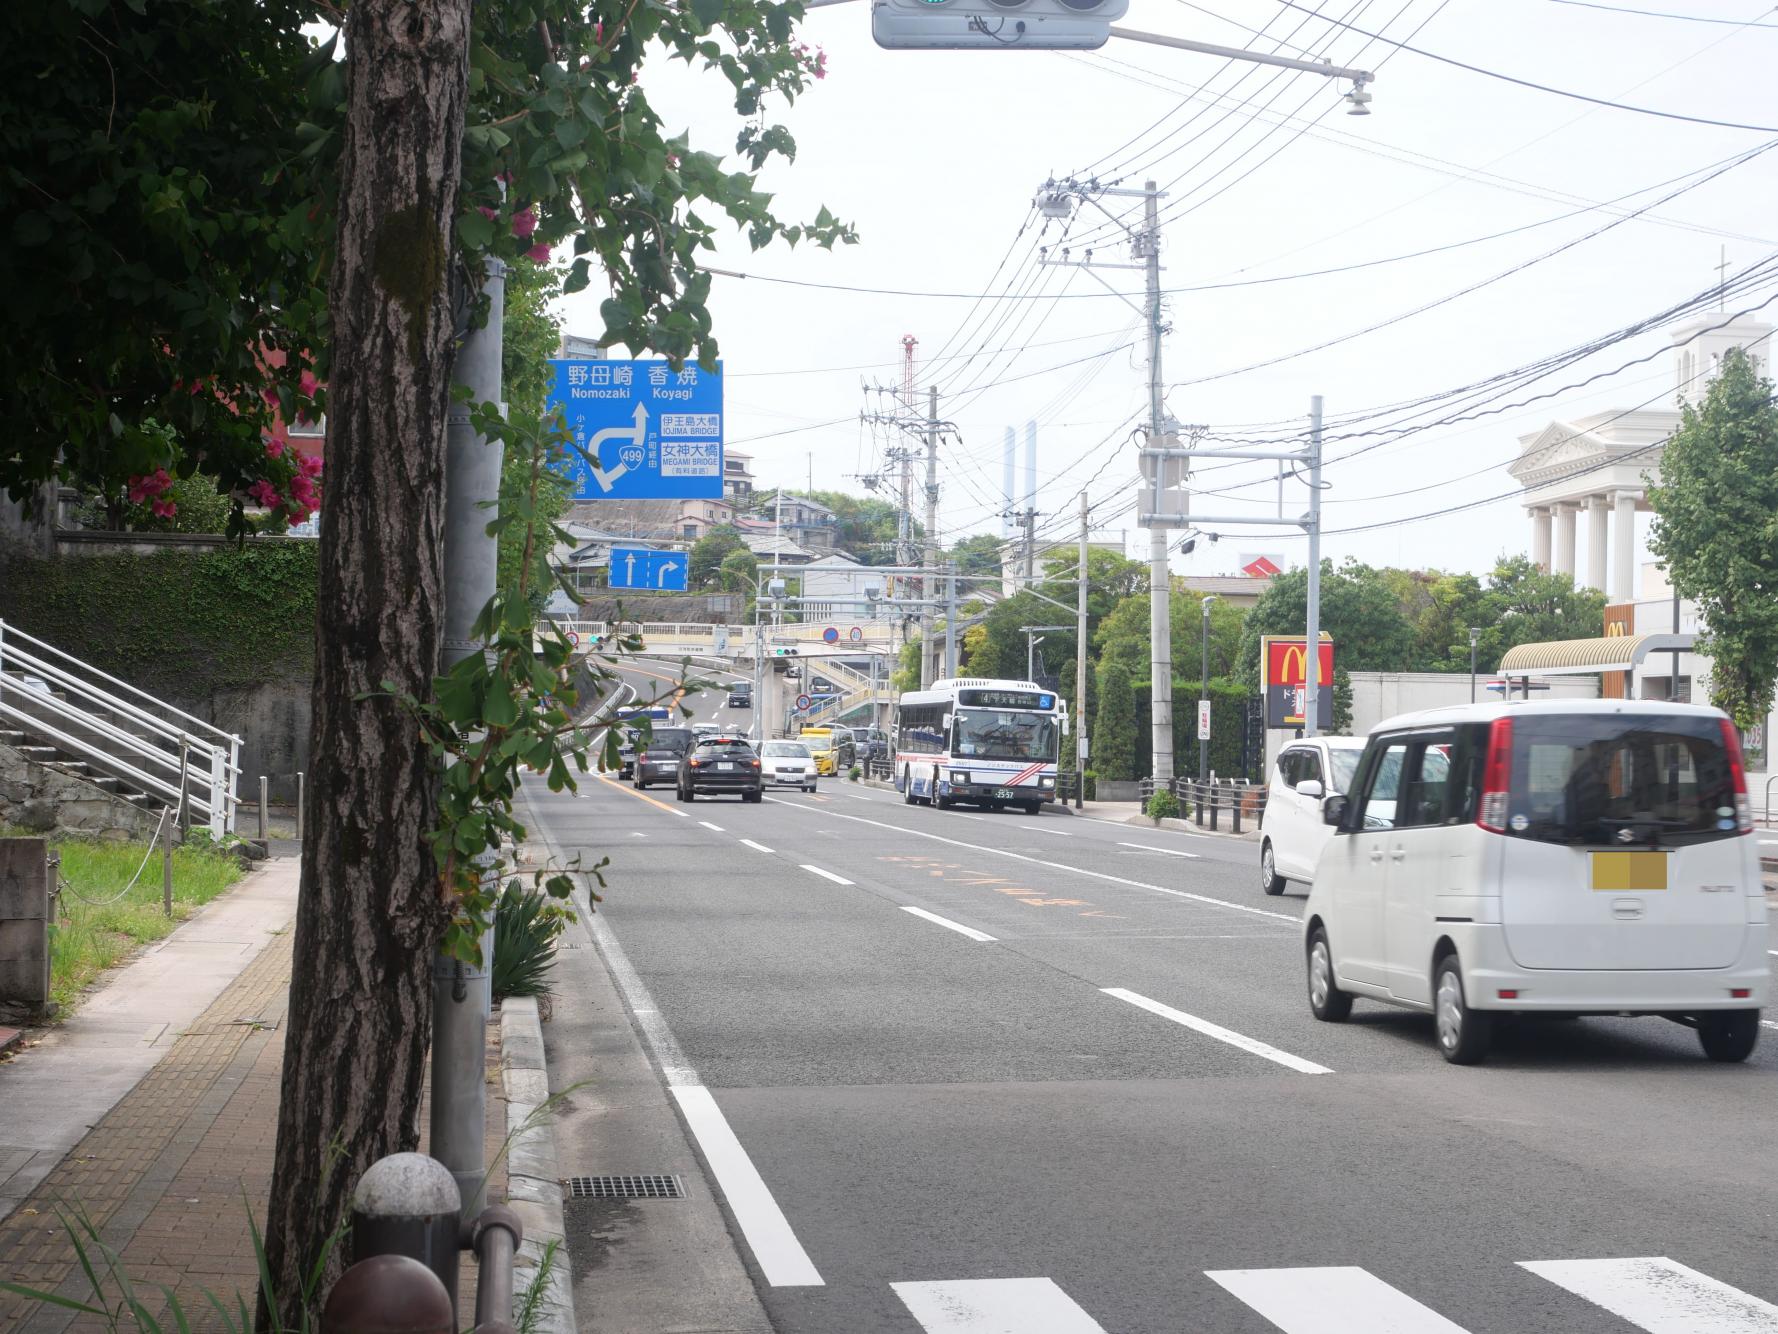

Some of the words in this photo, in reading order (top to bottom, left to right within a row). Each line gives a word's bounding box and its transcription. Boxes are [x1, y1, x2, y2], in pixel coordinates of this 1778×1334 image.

[568, 365, 633, 386] 野母崎
[648, 365, 698, 386] 香焼
[571, 387, 630, 399] Nomozaki
[652, 387, 693, 401] Koyagi
[662, 416, 718, 427] 伊王島大橋
[663, 427, 688, 435] IOJIMA
[690, 427, 718, 435] BRIDGE
[622, 450, 642, 462] 499
[662, 444, 718, 457] 女神大橋
[662, 458, 691, 466] MEGAMI
[692, 458, 718, 466] BRIDGE
